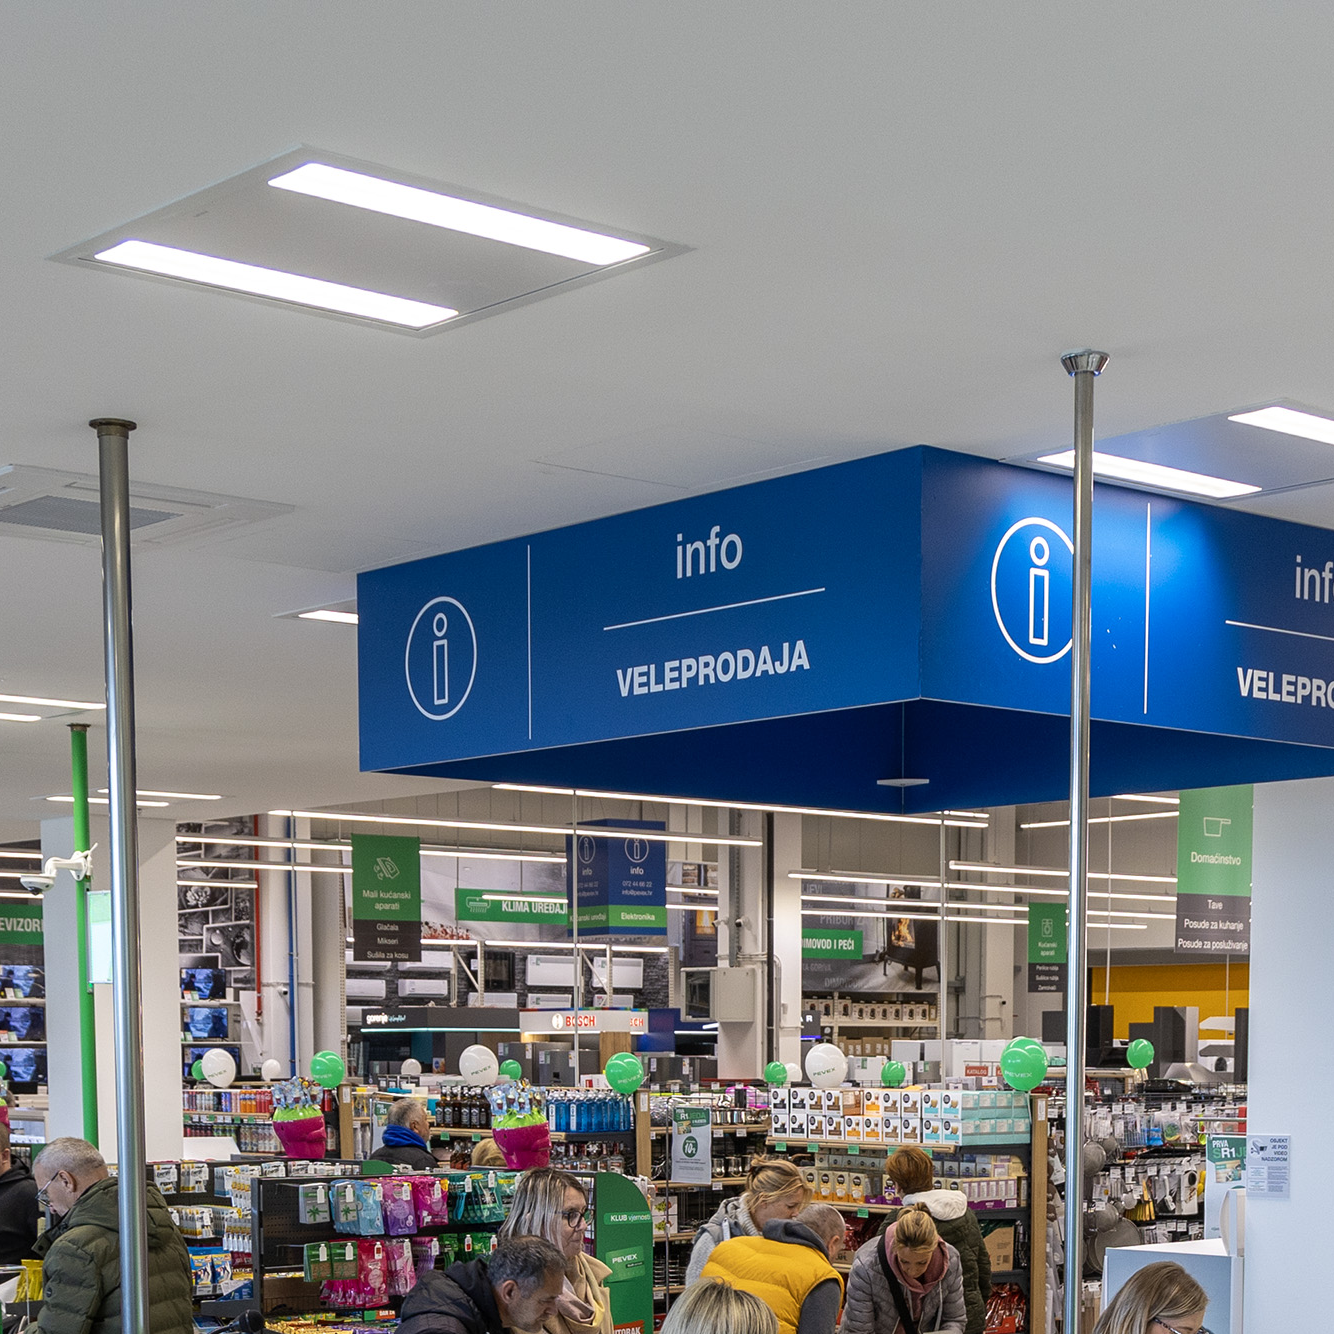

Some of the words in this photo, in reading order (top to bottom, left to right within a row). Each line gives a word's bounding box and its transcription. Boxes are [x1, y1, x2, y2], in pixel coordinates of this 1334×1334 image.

[676, 525, 743, 579] info
[616, 639, 811, 697] VELEPRODAJA
[1190, 851, 1242, 865] Domaćinstvo
[630, 866, 645, 875] info
[362, 889, 378, 898] Mali
[379, 889, 411, 899] kućanski
[374, 902, 400, 911] aparati
[501, 900, 529, 913] KLIMA
[1207, 899, 1223, 910] Tave
[620, 911, 656, 922] Elektronika
[1183, 918, 1209, 929] Posude
[838, 937, 855, 950] PEĆI
[1177, 938, 1202, 949] Posude
[1203, 941, 1211, 949] za
[366, 1013, 388, 1025] gorenje
[565, 1016, 596, 1027] BOSCH
[966, 1068, 988, 1076] KATALOG
[1212, 1140, 1229, 1148] PRVA
[610, 1214, 628, 1222] KLUB
[612, 1253, 638, 1264] PEVEX
